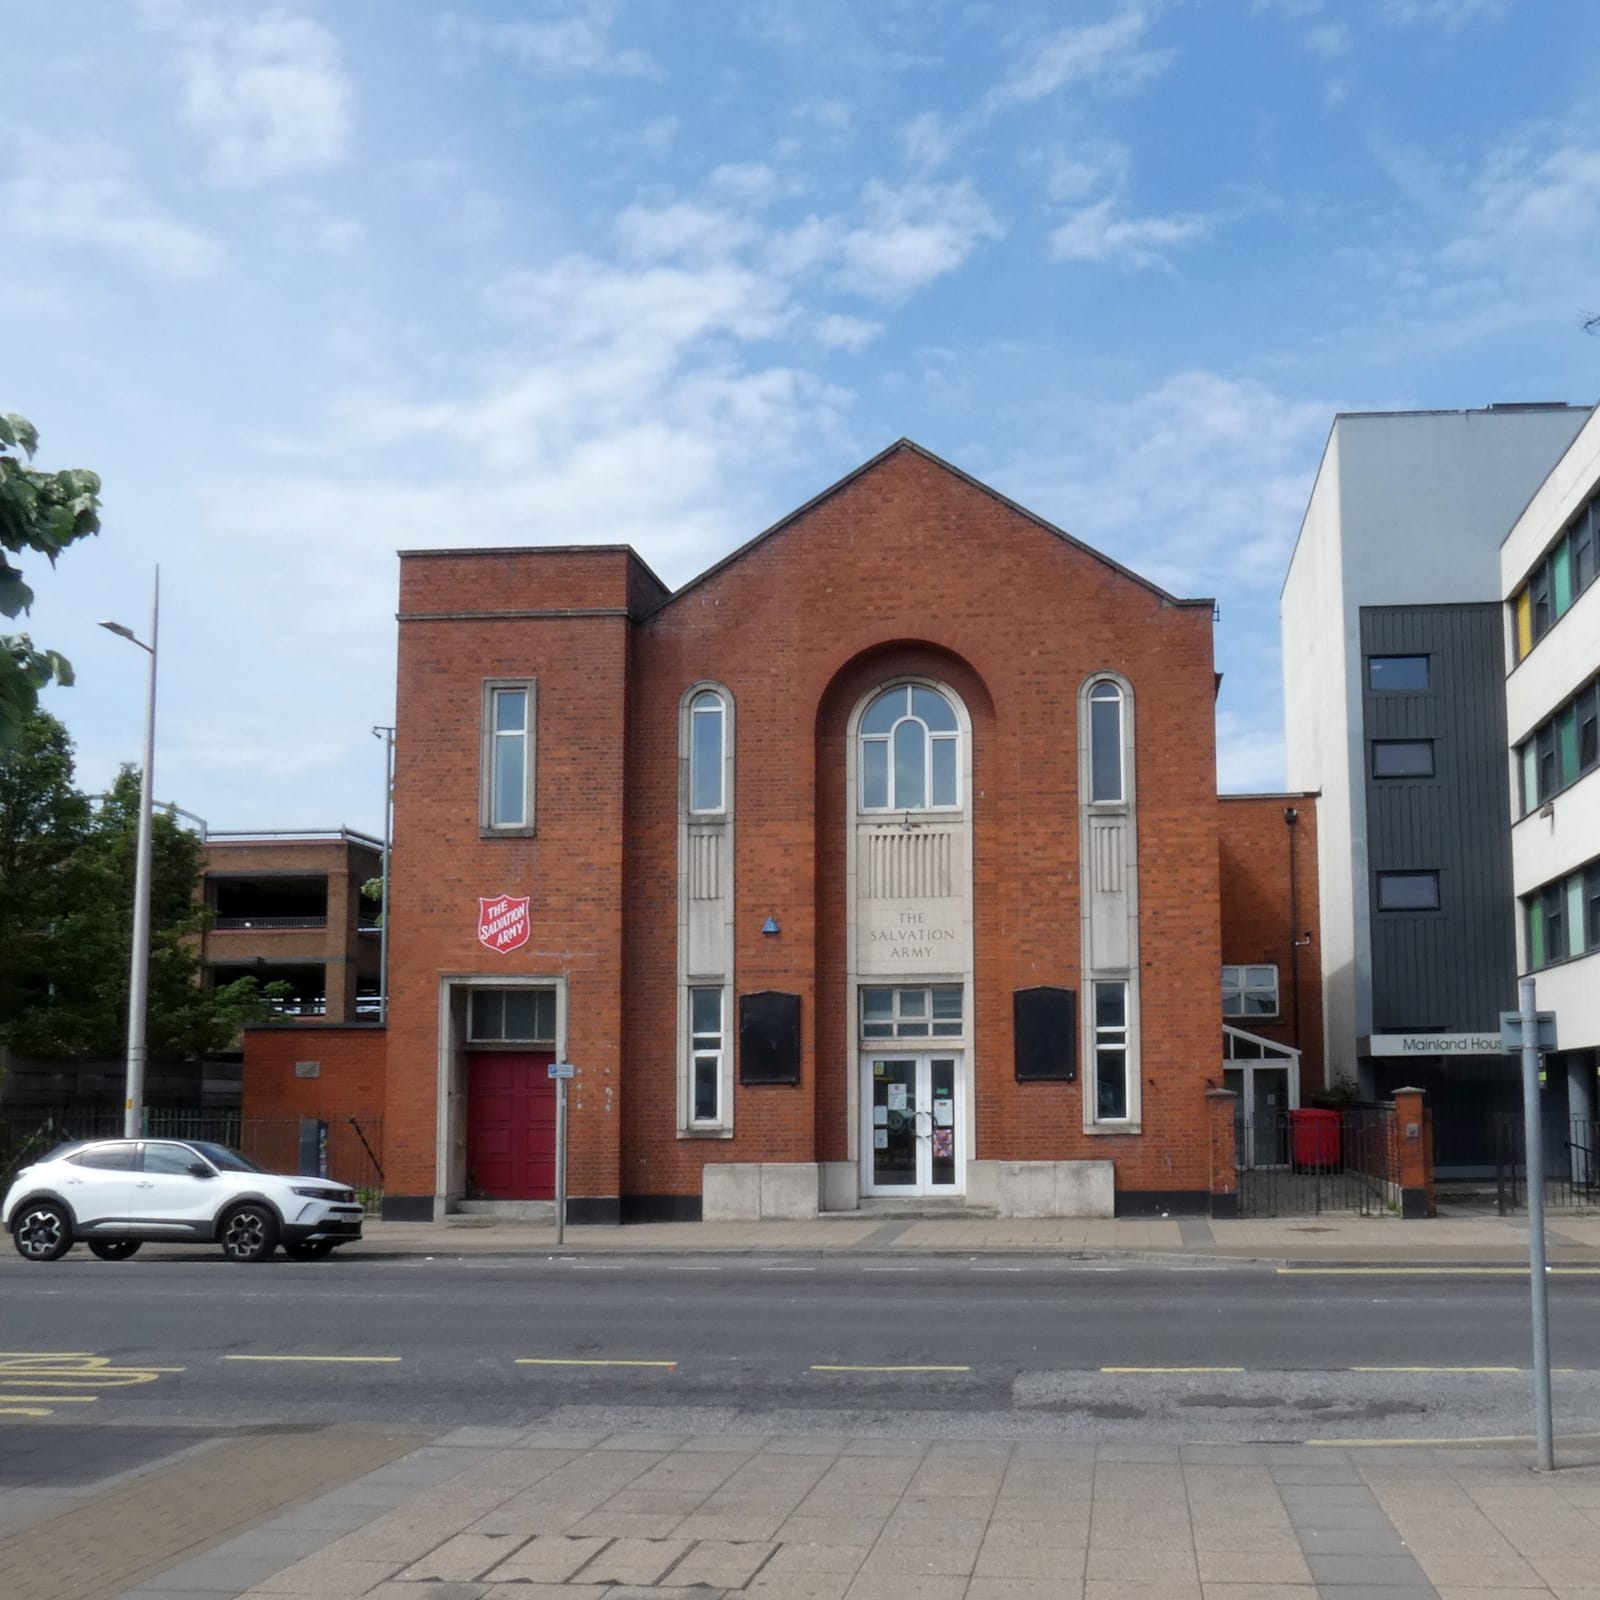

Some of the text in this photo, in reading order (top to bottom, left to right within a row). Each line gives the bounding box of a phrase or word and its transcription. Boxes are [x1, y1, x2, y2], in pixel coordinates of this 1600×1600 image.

[488, 900, 508, 920] THE
[481, 902, 525, 940] SALVATION
[898, 912, 926, 924] THE
[497, 920, 524, 946] ARMY
[871, 929, 954, 942] SALVATION
[891, 947, 933, 958] ARMY
[1403, 1038, 1503, 1051] Mainland Hous
